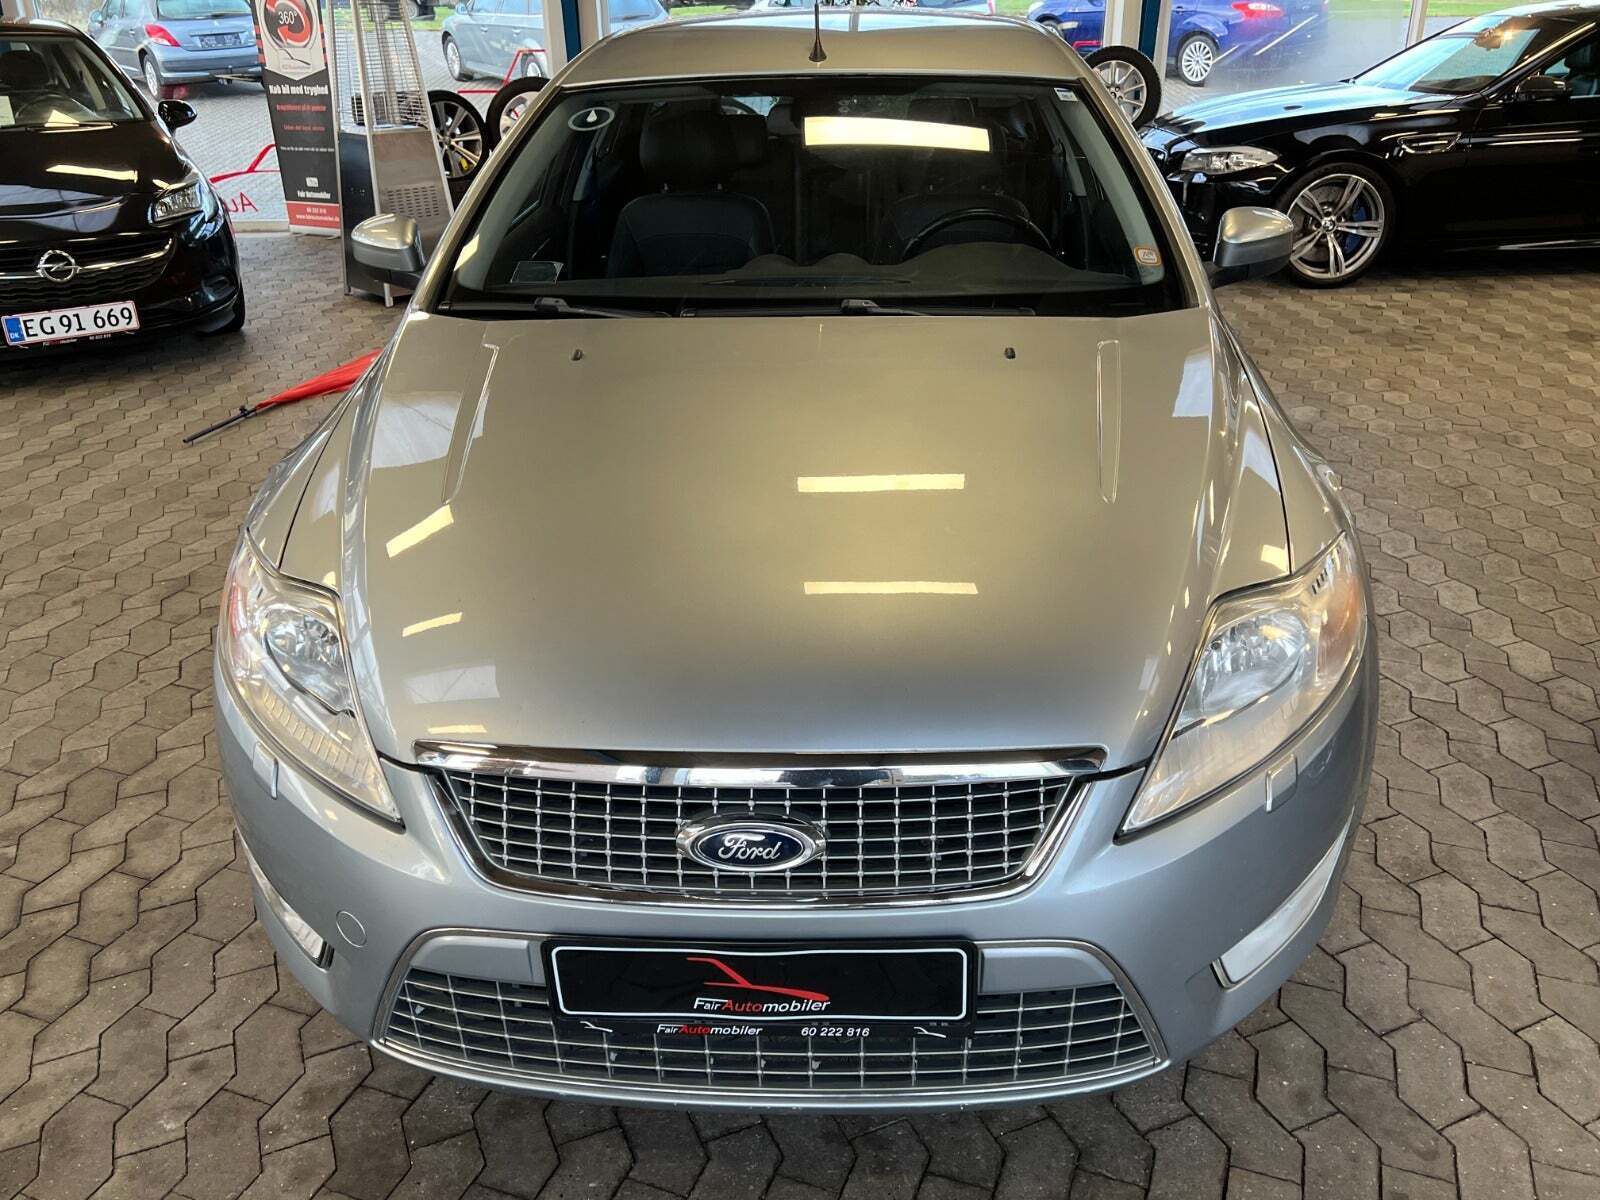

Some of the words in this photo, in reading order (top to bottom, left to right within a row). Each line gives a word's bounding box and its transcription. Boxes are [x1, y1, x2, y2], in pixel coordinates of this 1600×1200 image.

[279, 11, 298, 25] 360°
[22, 317, 56, 338] EG
[59, 313, 87, 334] 91
[93, 306, 134, 329] 669
[10, 331, 20, 339] DK
[717, 832, 782, 860] Ford
[693, 997, 831, 1013] FairAutomobiler
[656, 1023, 763, 1036] FairAutomobiler
[800, 1026, 817, 1037] 60
[819, 1027, 843, 1038] 222
[846, 1027, 870, 1038] 816
